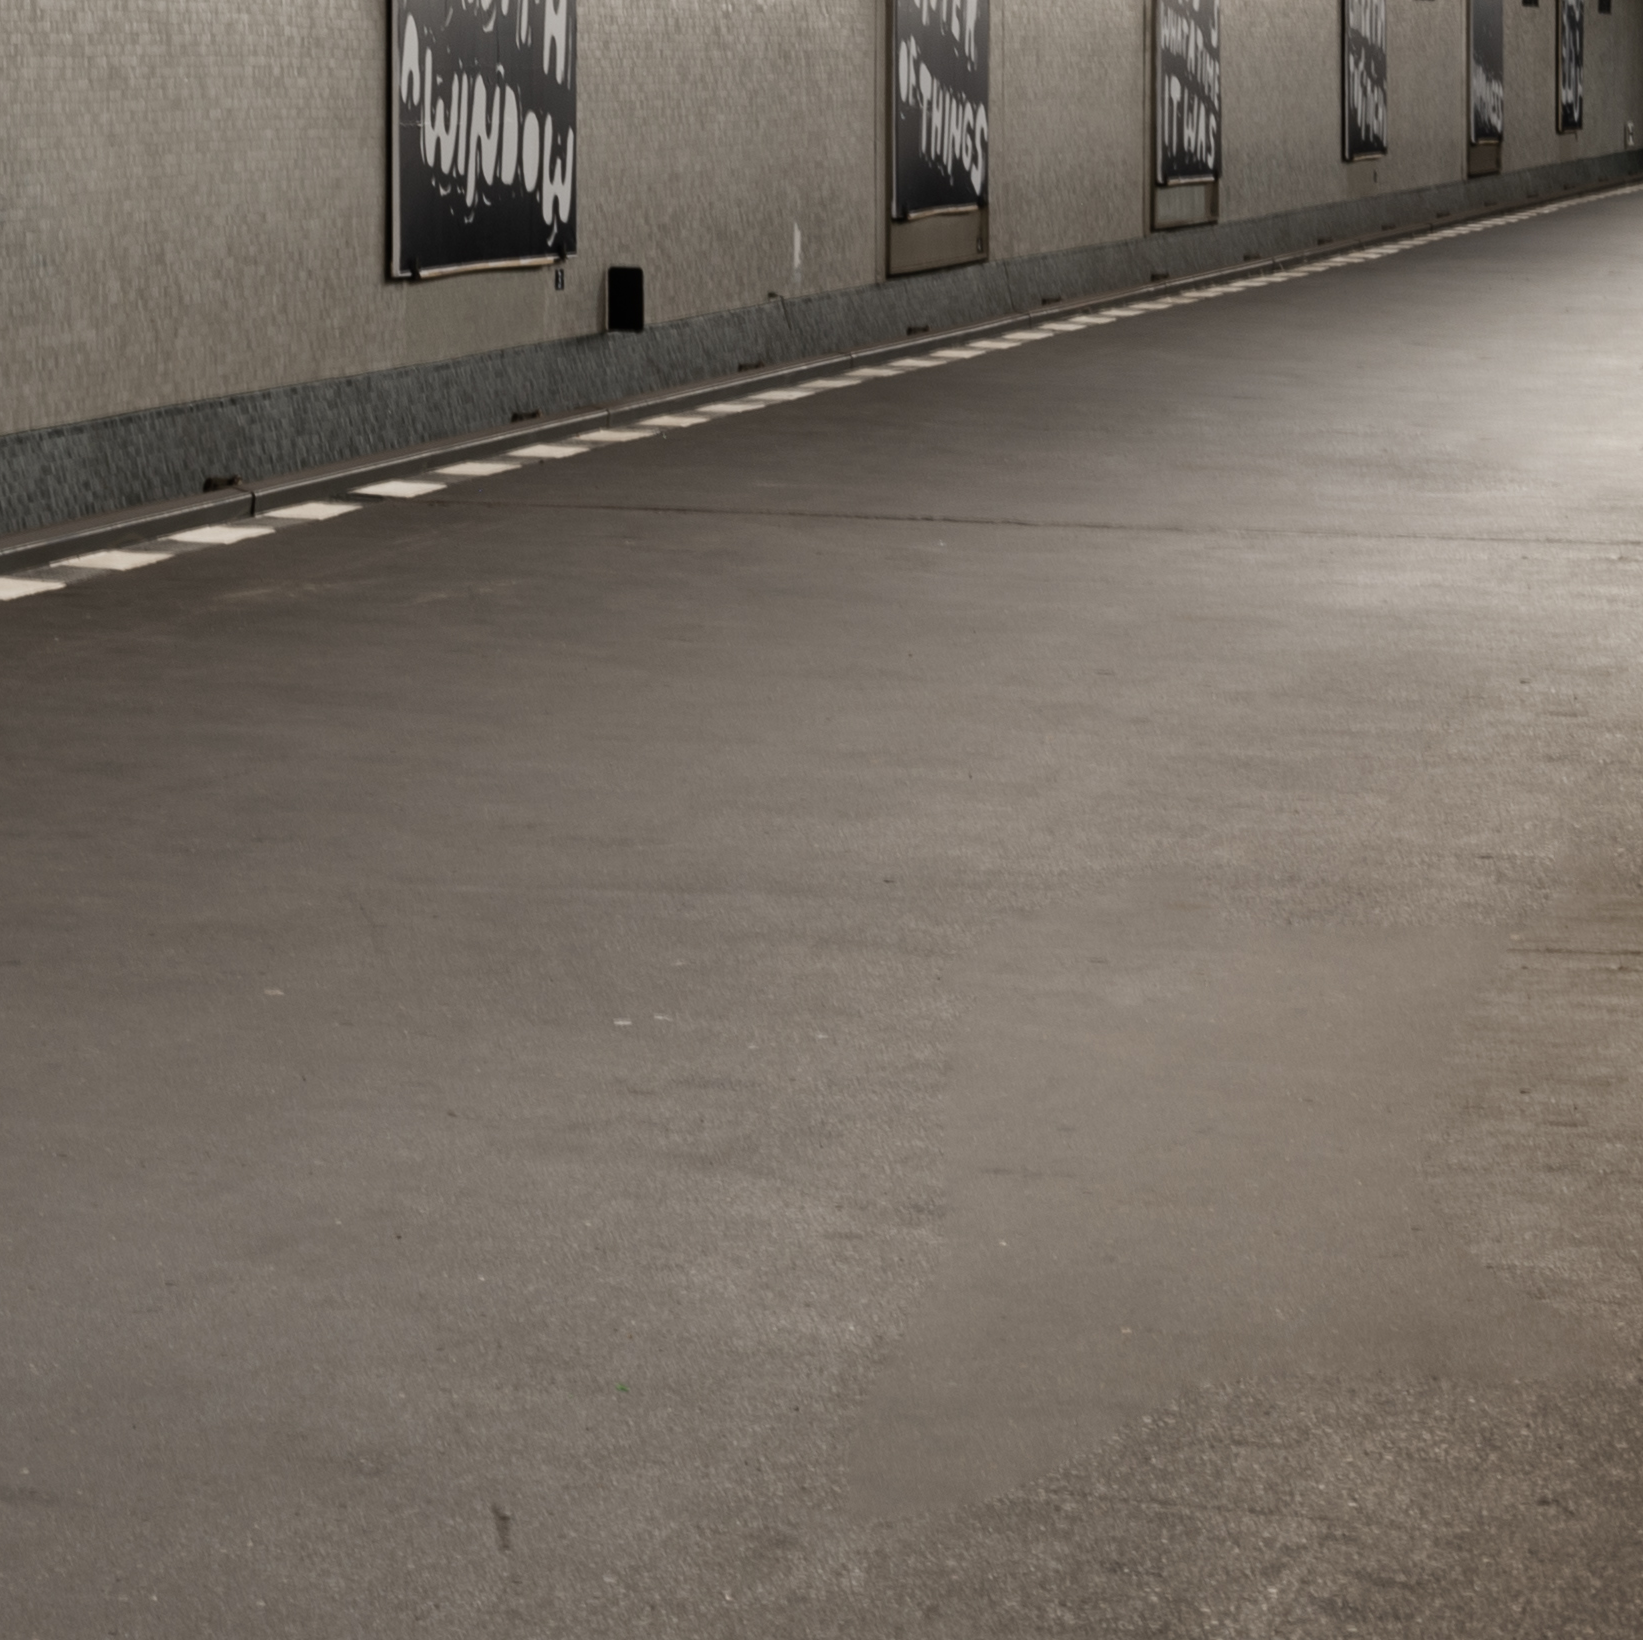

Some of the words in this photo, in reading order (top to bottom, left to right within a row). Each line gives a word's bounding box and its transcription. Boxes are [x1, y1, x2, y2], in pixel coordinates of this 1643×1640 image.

[400, 11, 421, 106] A
[422, 46, 574, 226] WINDOW
[898, 33, 918, 107] OF
[918, 60, 989, 196] THINGS
[1164, 73, 1182, 158] IT
[1183, 87, 1218, 170] WAS
